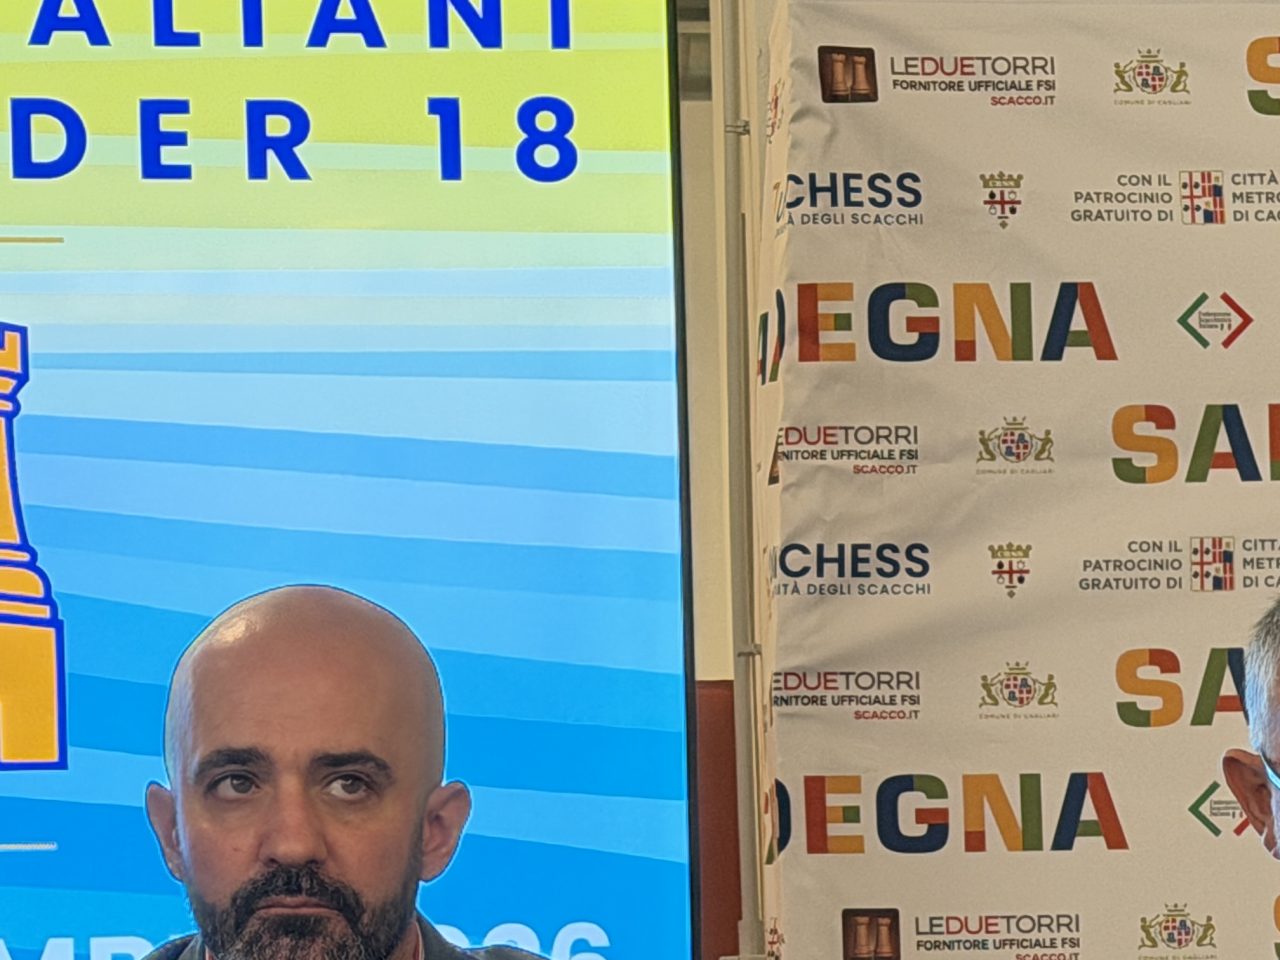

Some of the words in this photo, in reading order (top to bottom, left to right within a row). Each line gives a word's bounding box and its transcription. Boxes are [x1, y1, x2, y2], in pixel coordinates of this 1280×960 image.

[891, 57, 1055, 76] LEDUETORRI
[893, 80, 964, 91] FORNITORE
[968, 80, 1033, 91] UFFICIALE
[1037, 80, 1055, 91] FSI
[991, 96, 1055, 106] SCACCO.IT
[9, 97, 312, 181] DER
[427, 96, 579, 183] 18
[1117, 175, 1152, 186] CON
[1158, 174, 1172, 186] IL
[1231, 170, 1278, 185] CITTÀ
[1074, 192, 1172, 203] PATROCINIO
[801, 213, 844, 225] DEGLI
[851, 213, 923, 225] SCACCHI
[1071, 209, 1152, 221] GRATUITO
[1158, 210, 1173, 221] DI
[1233, 210, 1249, 221] DI
[797, 281, 1118, 362] EGNA
[831, 449, 896, 460] UFFICIALE
[899, 449, 918, 460] FSI
[853, 465, 917, 474] SCACCO.IT
[1128, 541, 1163, 553] CON
[1169, 541, 1183, 552] IL
[1083, 559, 1182, 571] PATROCINIO
[1079, 577, 1160, 590] GRATUITO
[1167, 577, 1182, 589] DI
[1243, 576, 1258, 588] DI
[807, 584, 851, 595] DEGLI
[857, 583, 930, 595] SCACCHI
[831, 695, 897, 706] UFFICIALE
[901, 695, 920, 705] FSI
[854, 710, 920, 720] SCACCO.IT
[915, 914, 1079, 935] LEDUETORRI
[917, 939, 989, 951] FORNITORE
[993, 938, 1057, 950] UFFICIALE
[1061, 937, 1080, 948] FSI
